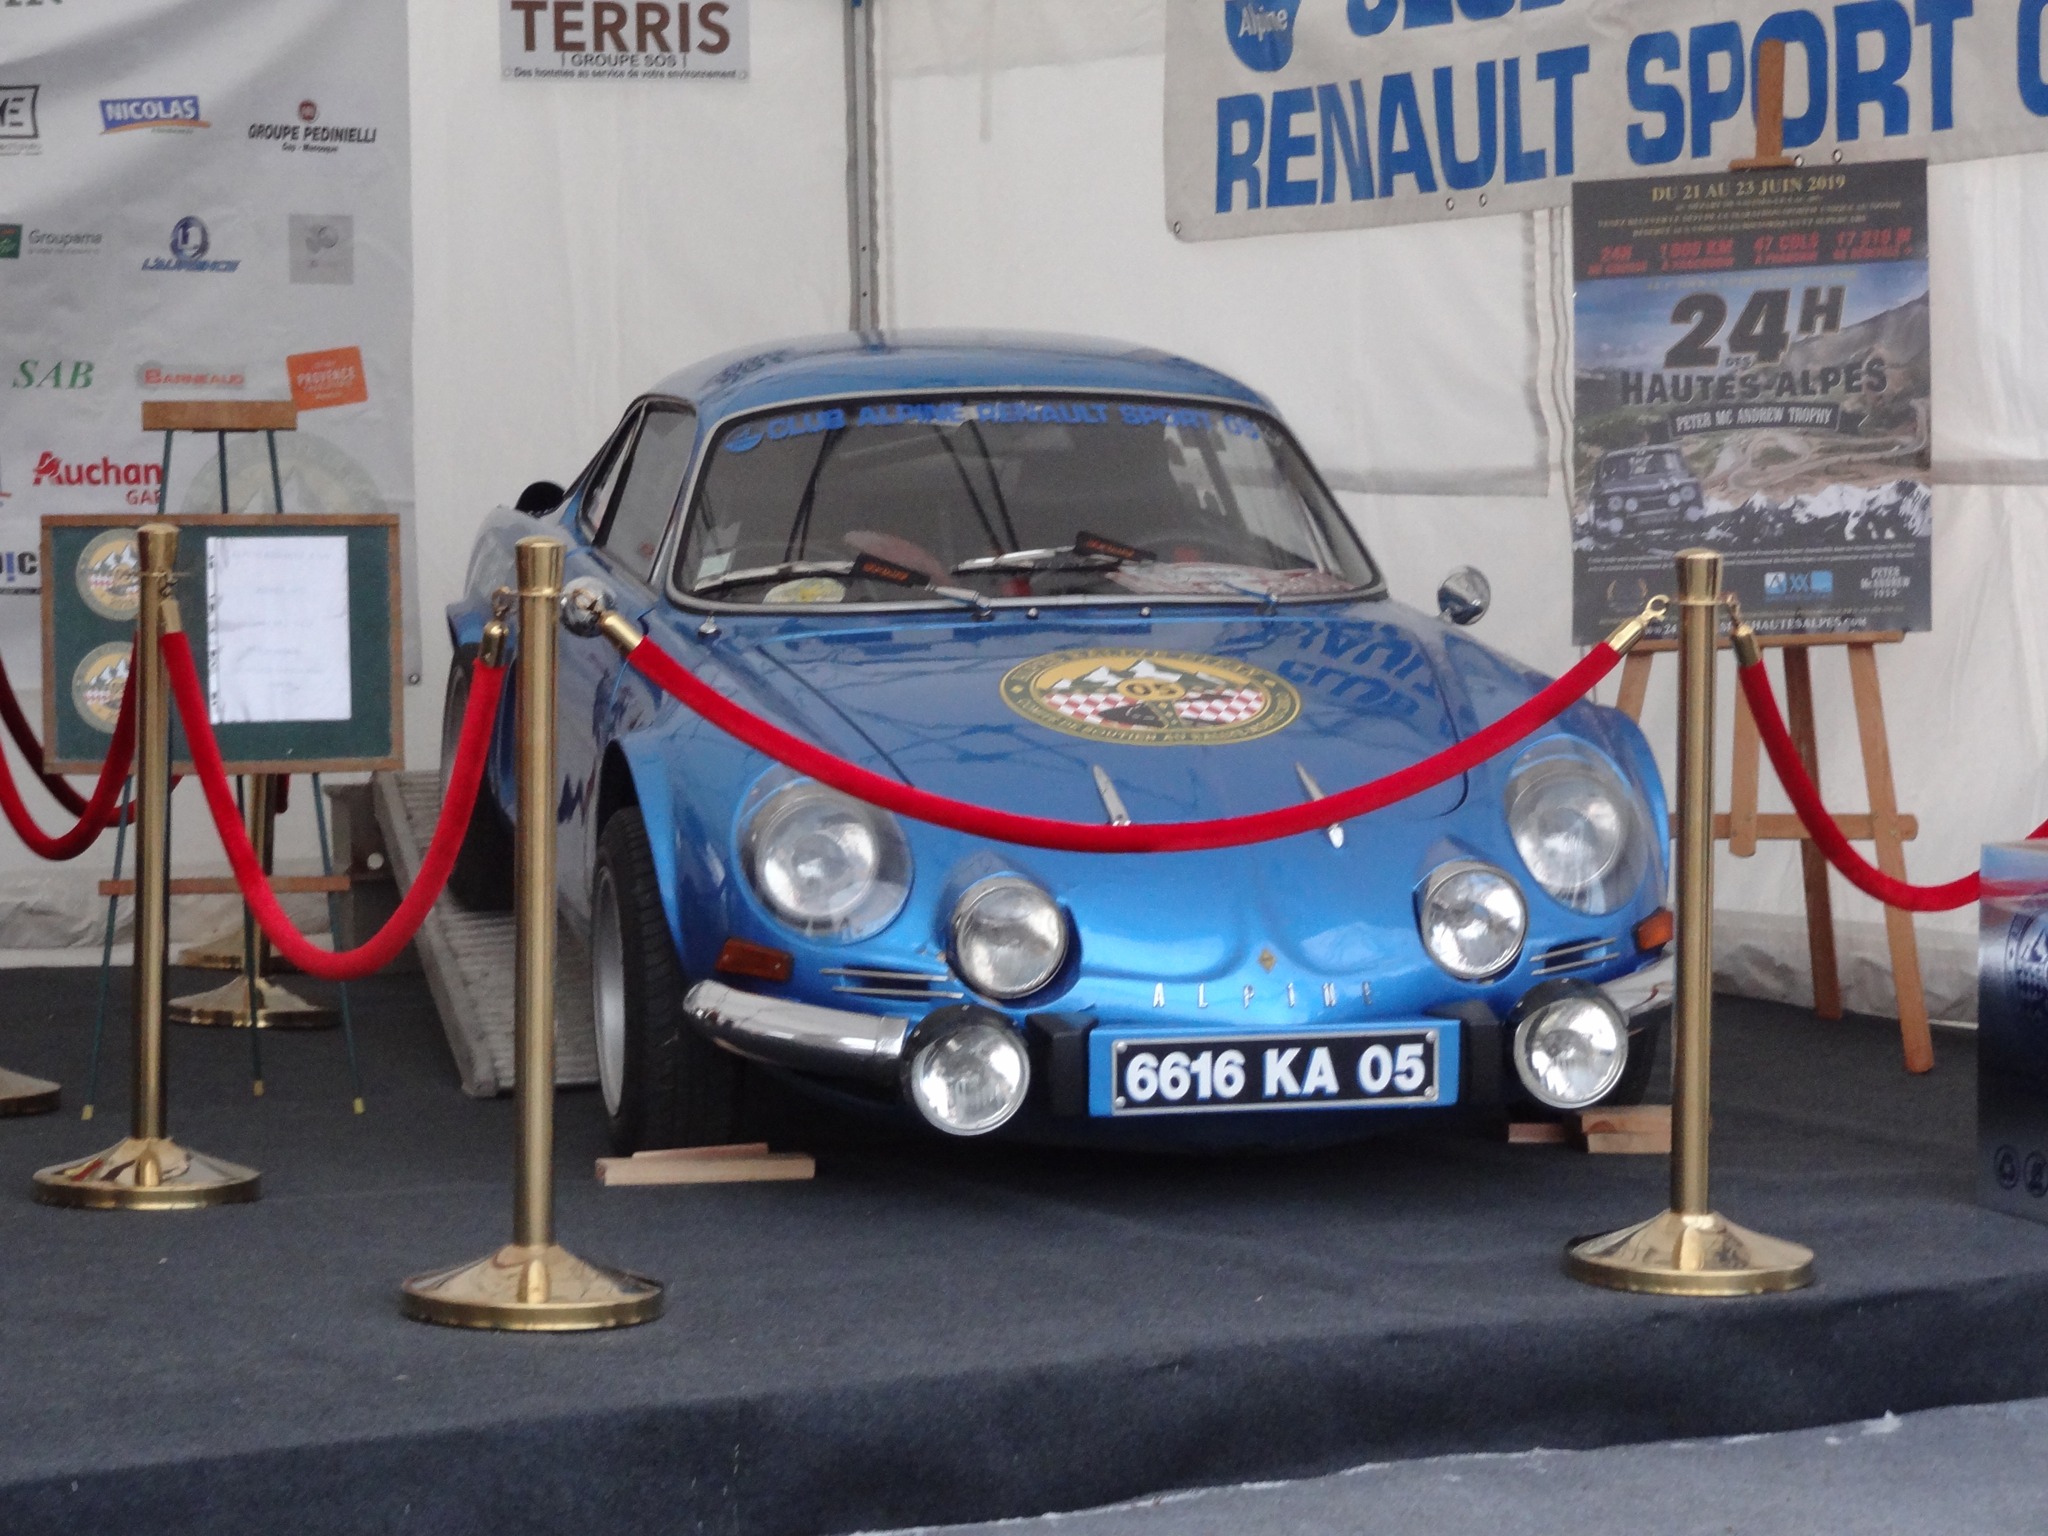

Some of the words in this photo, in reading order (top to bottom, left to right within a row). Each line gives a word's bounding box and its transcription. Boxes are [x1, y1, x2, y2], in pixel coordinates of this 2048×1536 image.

[511, 0, 730, 54] TERRIS
[1238, 7, 1289, 42] Alpine
[570, 54, 640, 67] GROUPE
[643, 54, 676, 68] SOS
[106, 99, 196, 120] NICOLAS
[1215, 43, 1590, 214] RENAULT
[1627, 0, 1973, 166] SPORT
[247, 123, 299, 140] GROUPE
[303, 125, 377, 143] PEDINIELLI
[1652, 186, 1677, 202] DU
[1683, 185, 1700, 200] 21
[1705, 183, 1730, 199] AU
[1736, 181, 1755, 196] 23
[1759, 178, 1802, 195] JUIN
[1807, 174, 1846, 191] 2019
[28, 230, 102, 247] Groupama
[12, 360, 95, 389] SAB
[1620, 357, 1887, 404] HAUTES-ALPES
[767, 408, 846, 440] CLUB
[1676, 414, 1711, 432] PETER
[1737, 407, 1784, 425] ANDREW
[1787, 406, 1833, 425] TROPHY
[33, 451, 163, 485] Auchan
[1153, 981, 1373, 1008] ALPINE
[1124, 1049, 1246, 1100] 6616
[1263, 1046, 1339, 1099] KA
[1357, 1043, 1425, 1094] 05
